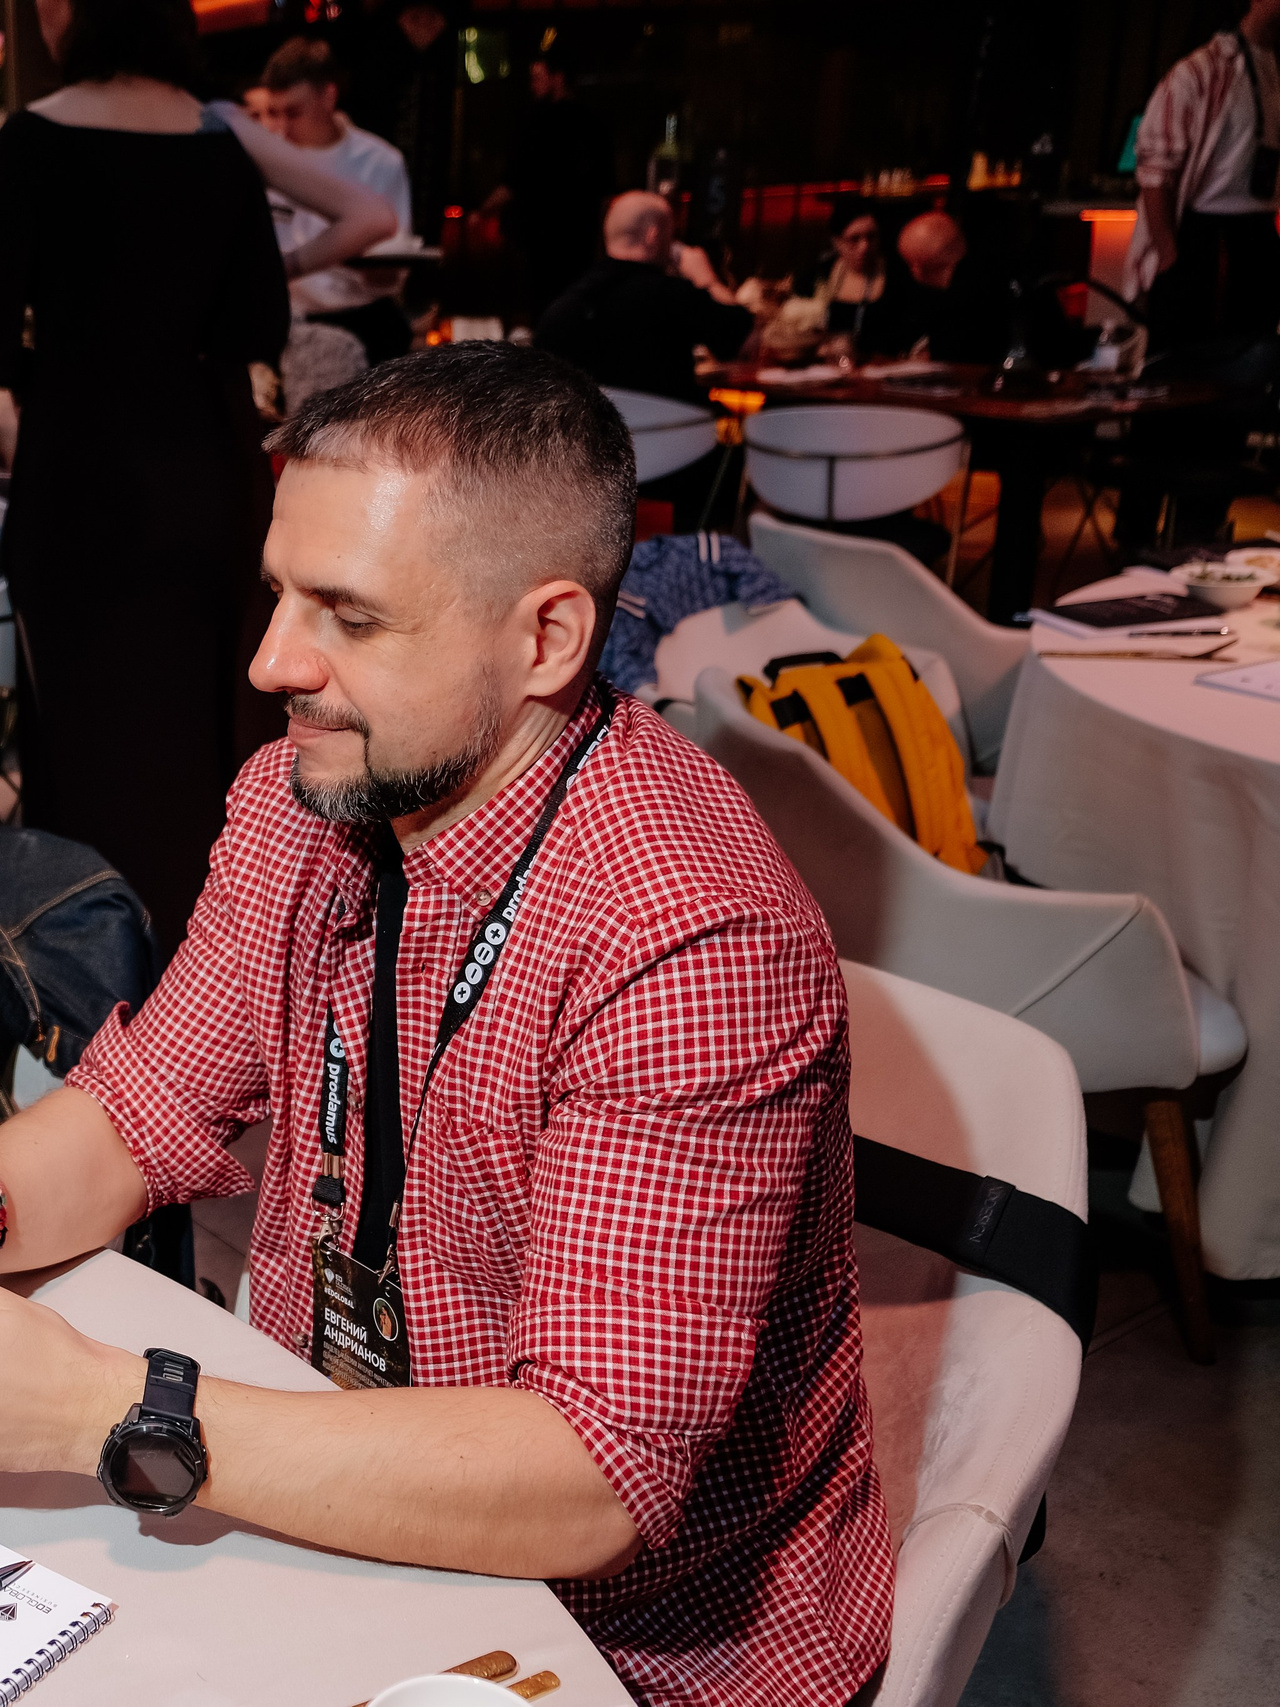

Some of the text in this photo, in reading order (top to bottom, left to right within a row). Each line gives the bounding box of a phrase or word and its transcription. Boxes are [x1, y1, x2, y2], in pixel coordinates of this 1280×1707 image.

[325, 1062, 341, 1145] prodamus
[324, 1307, 368, 1344] ЕВГЕНИЙ
[324, 1324, 386, 1372] АНДРИАНОВ
[3, 1585, 53, 1615] EDGLOBA
